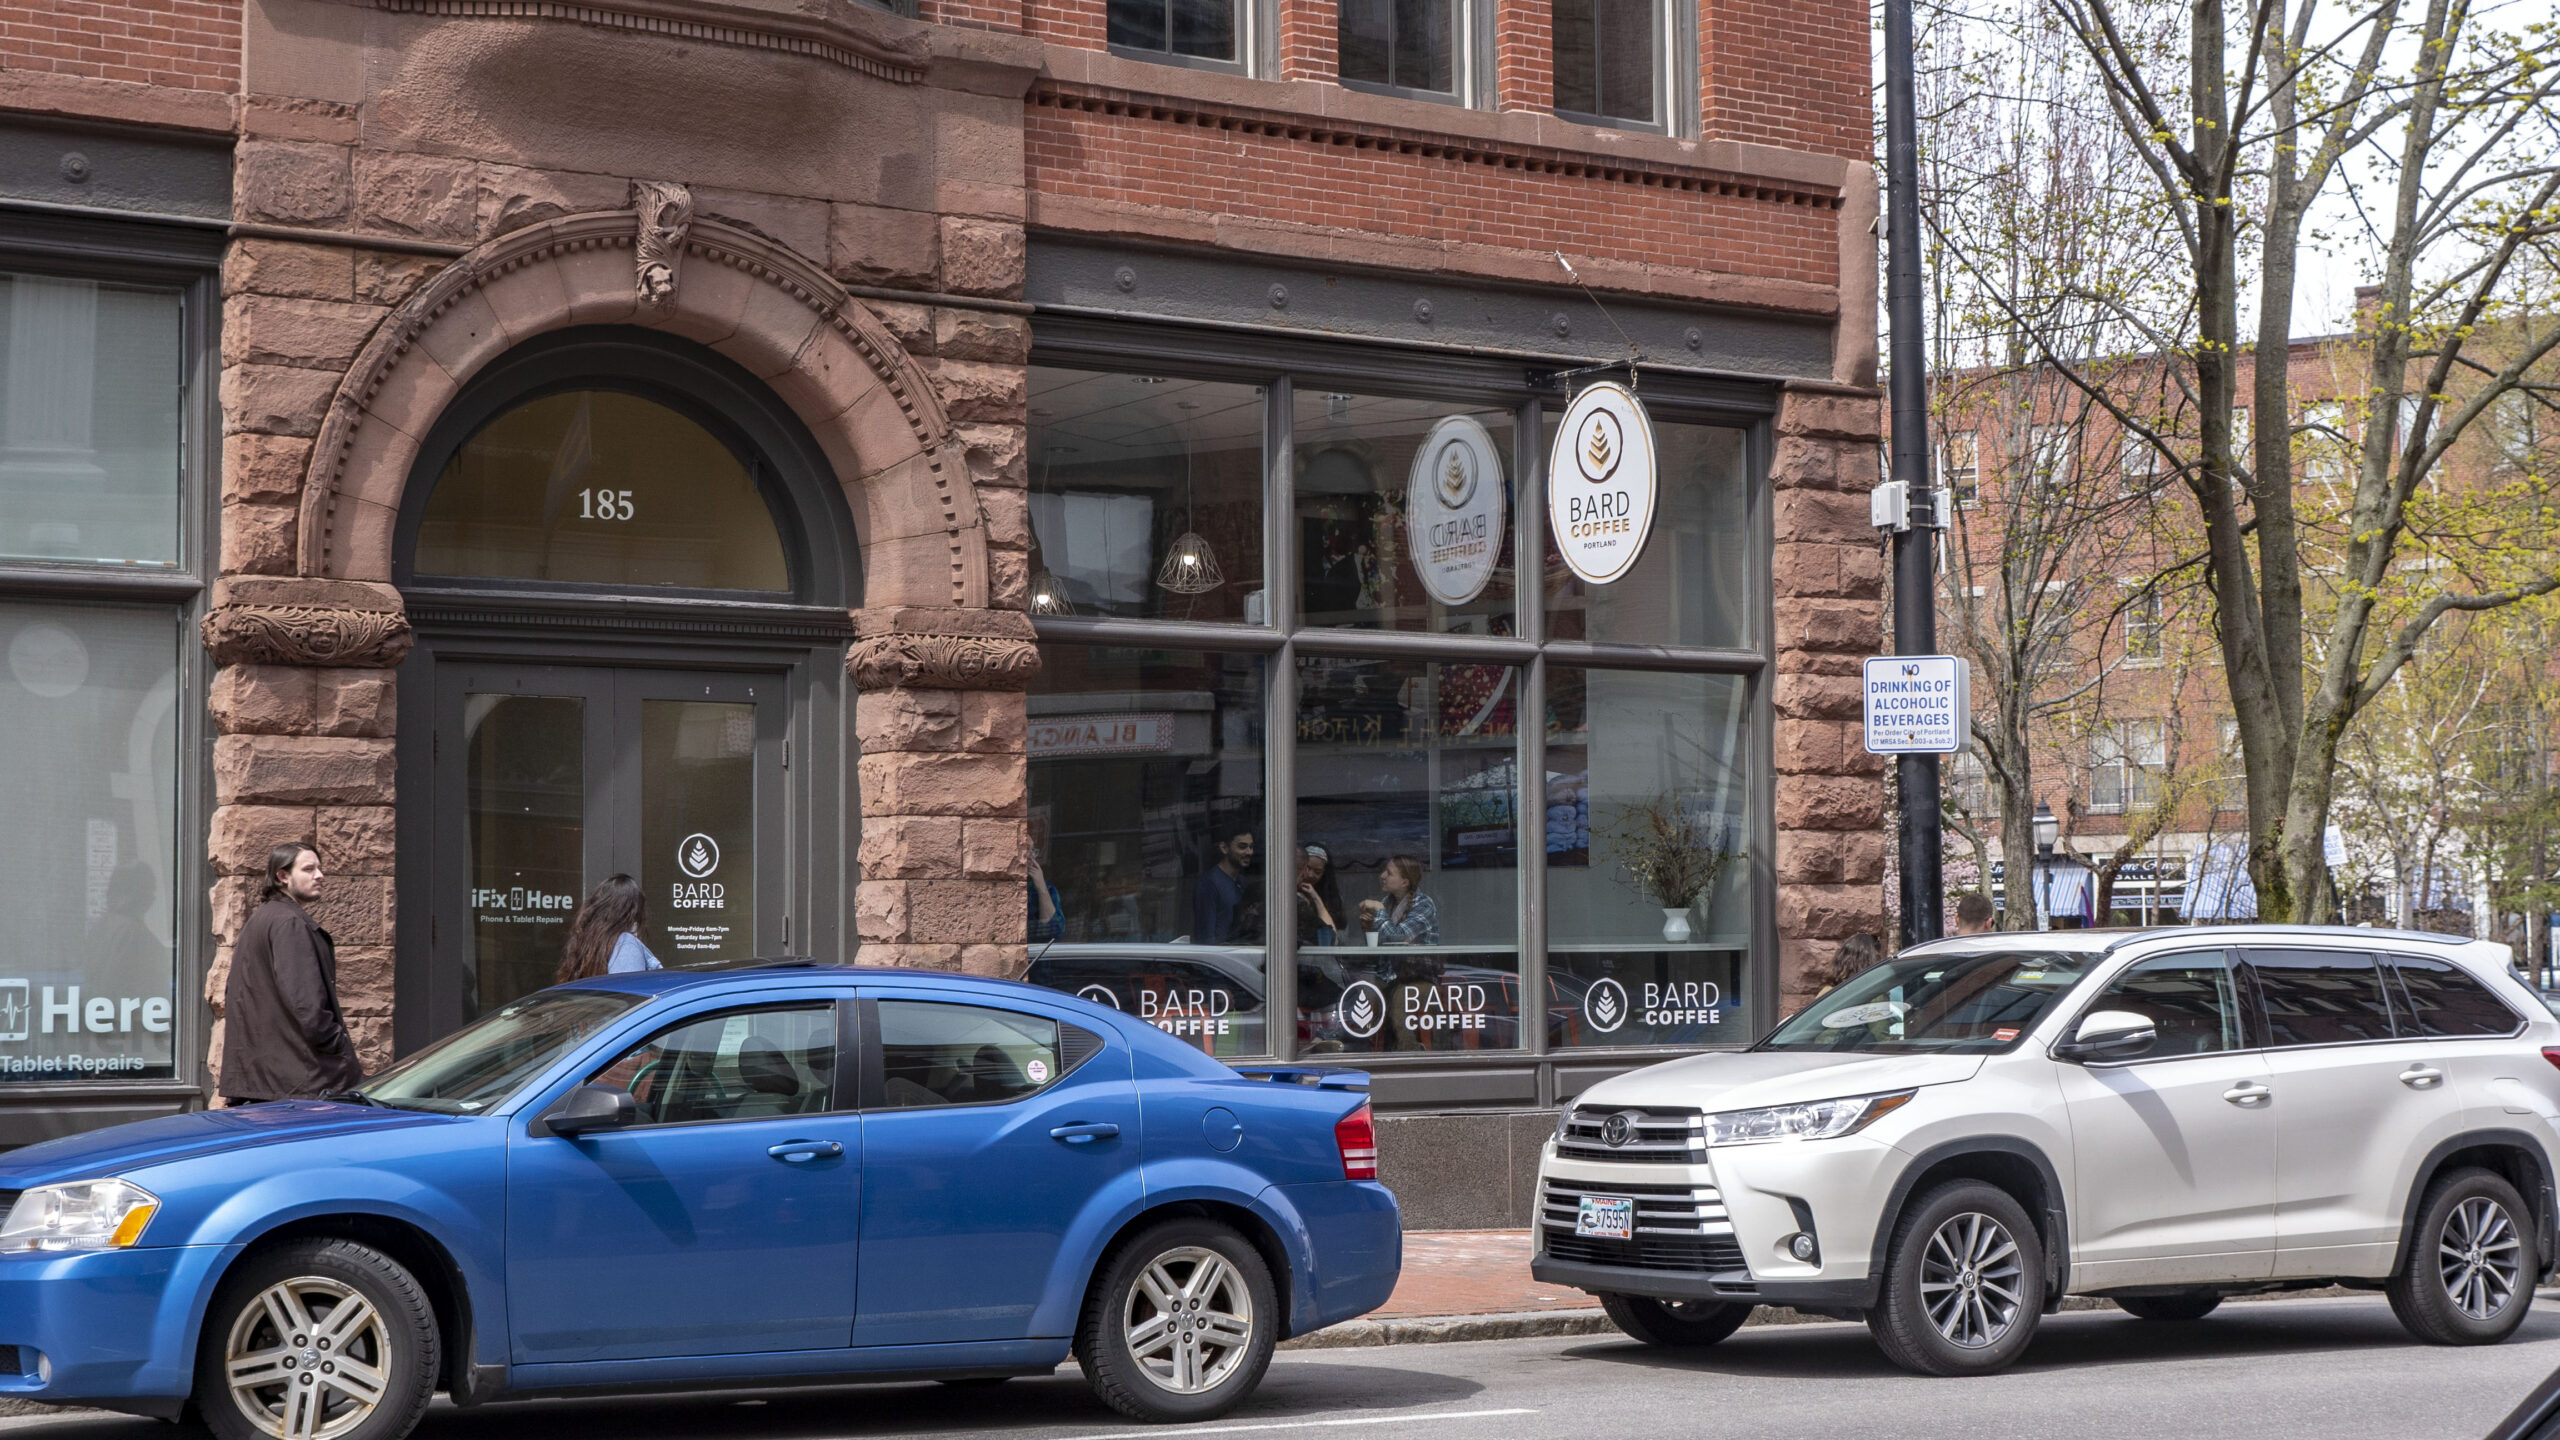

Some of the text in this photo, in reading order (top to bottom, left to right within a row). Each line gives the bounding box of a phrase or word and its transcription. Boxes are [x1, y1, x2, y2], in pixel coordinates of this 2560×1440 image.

[579, 488, 634, 520] 185
[1570, 491, 1630, 522] BARD
[1570, 518, 1630, 539] COFFEE
[1583, 539, 1617, 550] PORTLAND
[1902, 664, 1920, 676] NO
[1871, 680, 1951, 693] DRINKING OF
[1875, 697, 1948, 710] ALCOHOLIC
[1874, 714, 1949, 726] BEVERAGES
[471, 888, 573, 909] iFix Here
[673, 883, 724, 899] BARD
[673, 899, 724, 908] COFFEE
[480, 915, 563, 924] Phone & Tablet Repairs
[1141, 989, 1230, 1017] BARD
[1405, 985, 1485, 1013] BARD
[1644, 982, 1720, 1009] BARD
[41, 986, 171, 1034] Here
[1645, 1009, 1720, 1025] COFFEE
[1146, 1019, 1230, 1035] OFFEE
[1405, 1013, 1486, 1031] COFFEE
[0, 1053, 145, 1074] Tablet Repairs
[1594, 1198, 1616, 1206] MAINE
[1600, 1208, 1629, 1230] 7595N
